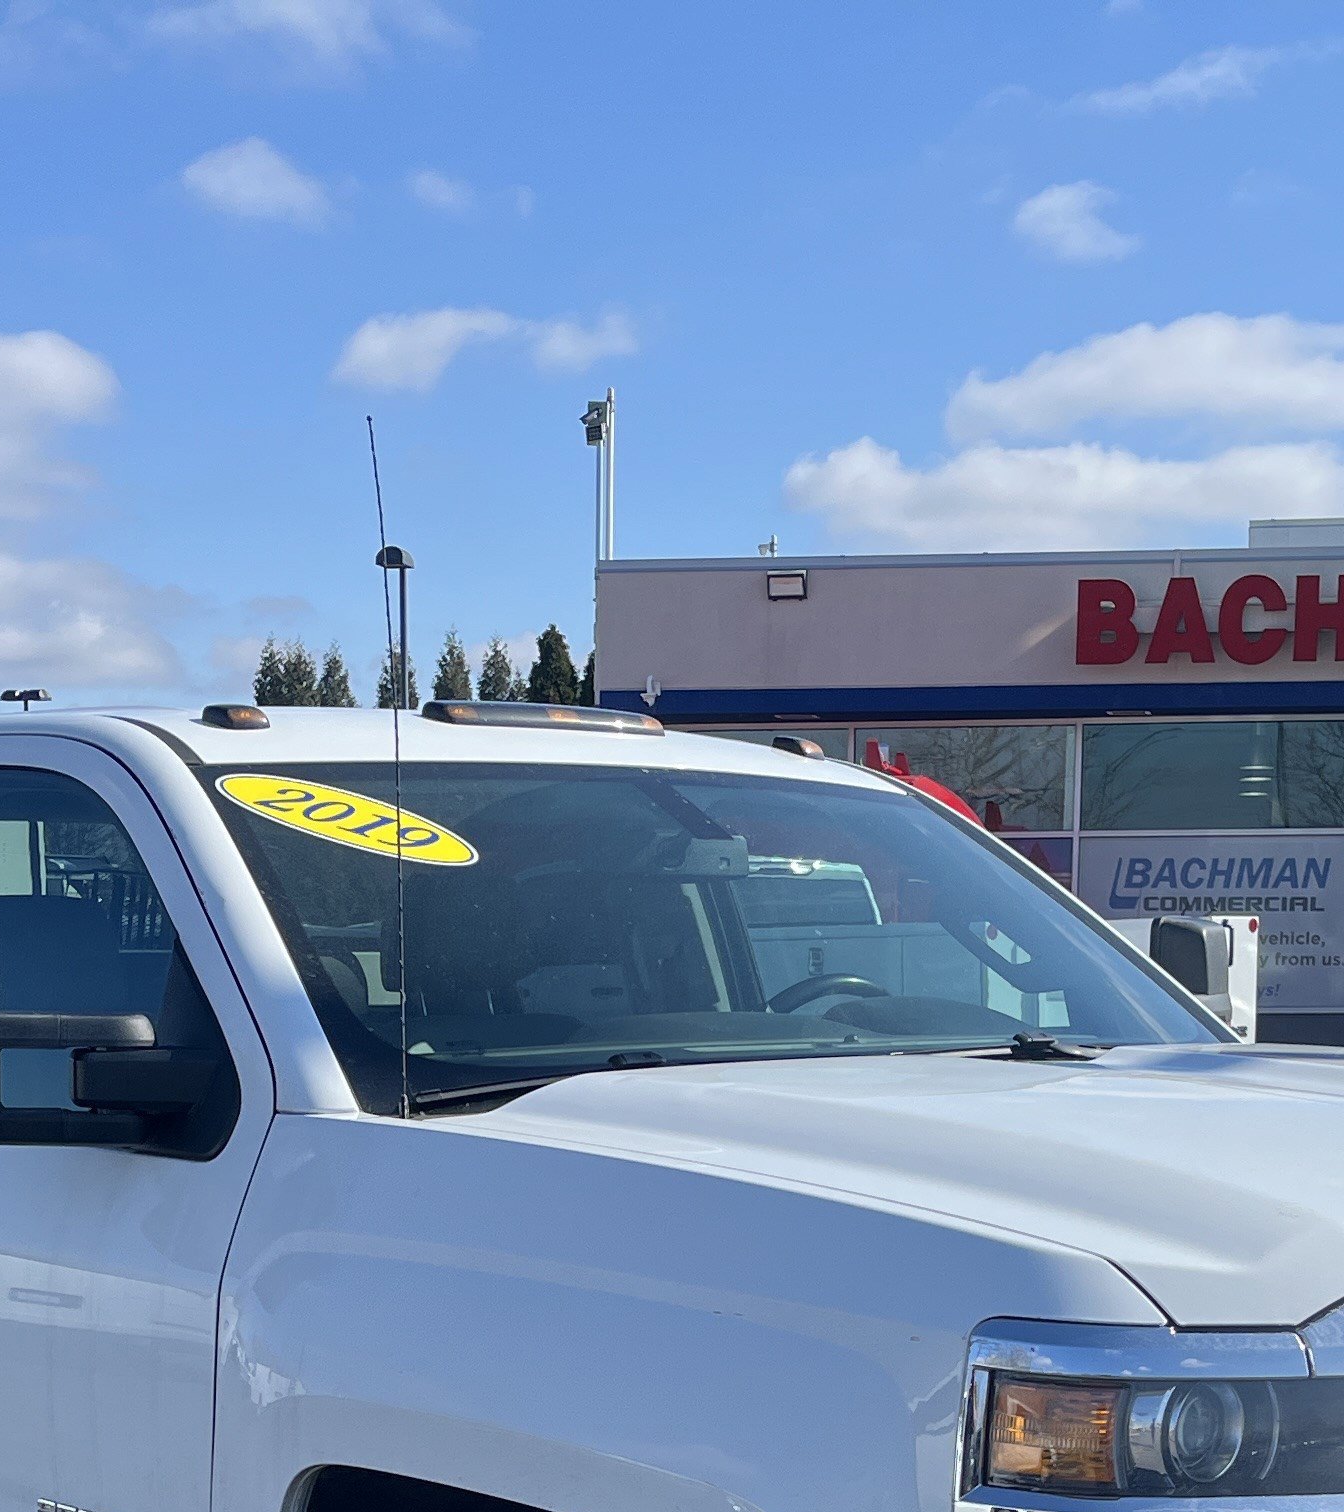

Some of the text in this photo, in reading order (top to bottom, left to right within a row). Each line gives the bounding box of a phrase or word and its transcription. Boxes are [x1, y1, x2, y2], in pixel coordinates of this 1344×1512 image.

[252, 788, 441, 849] 2019
[1123, 857, 1332, 889] BACHMAN
[1143, 896, 1326, 912] COMMERCIAL
[1259, 931, 1326, 948] vehicle,
[1275, 951, 1316, 966] from
